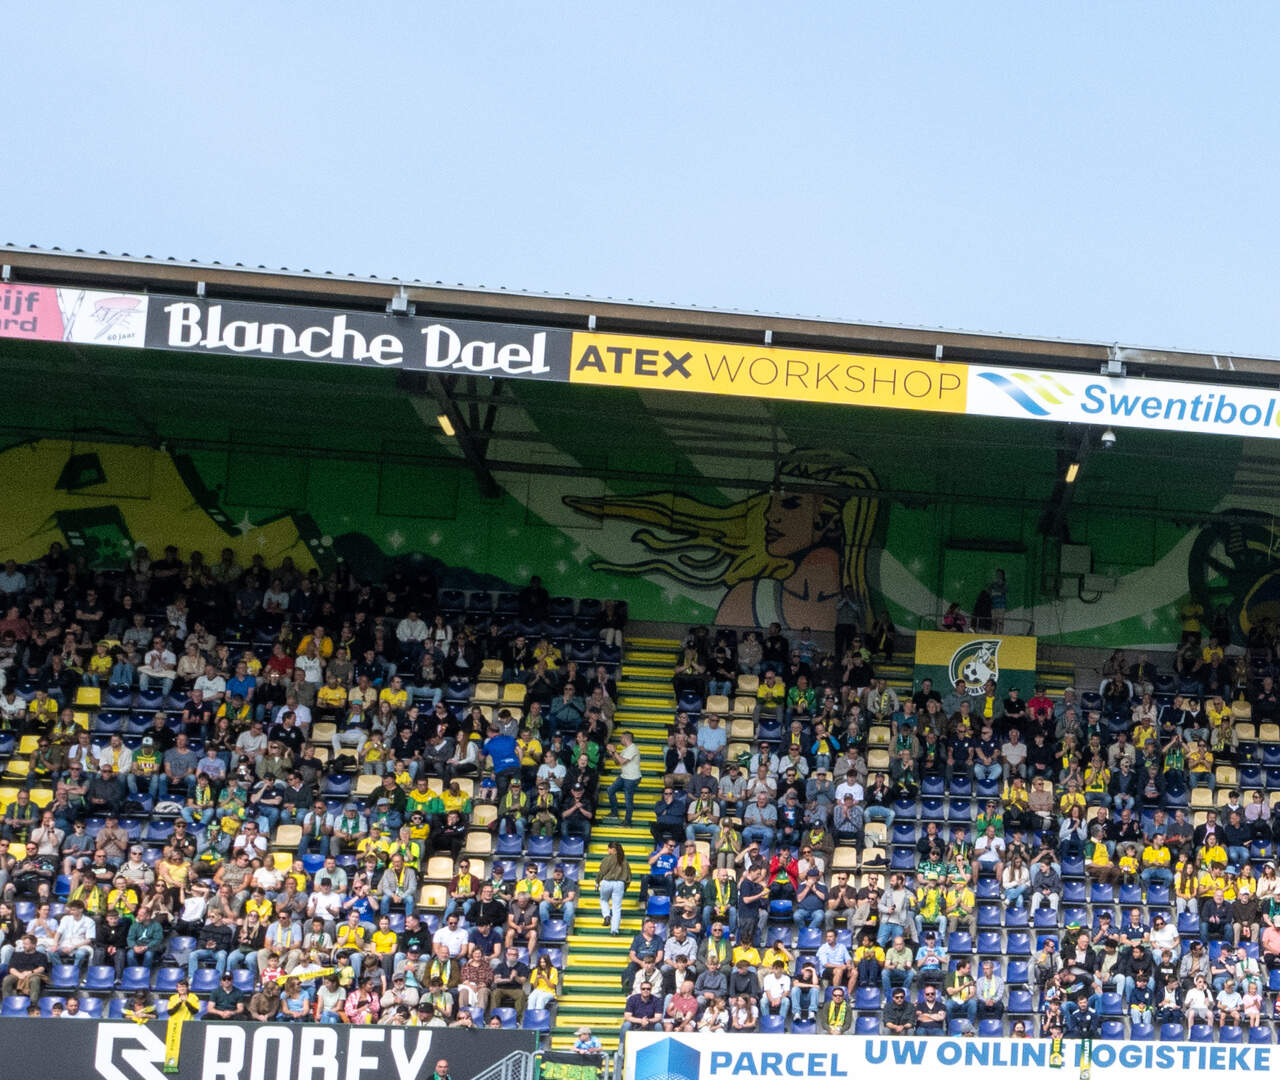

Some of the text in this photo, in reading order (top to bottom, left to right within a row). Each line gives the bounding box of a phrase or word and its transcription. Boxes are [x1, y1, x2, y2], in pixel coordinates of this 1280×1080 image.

[0, 289, 40, 315] ijf
[0, 317, 38, 332] rd
[164, 302, 550, 375] Blanche Dael
[575, 344, 961, 400] ATEX WORKSHOP
[709, 1052, 848, 1077] PARCEL
[865, 1039, 928, 1065] UW
